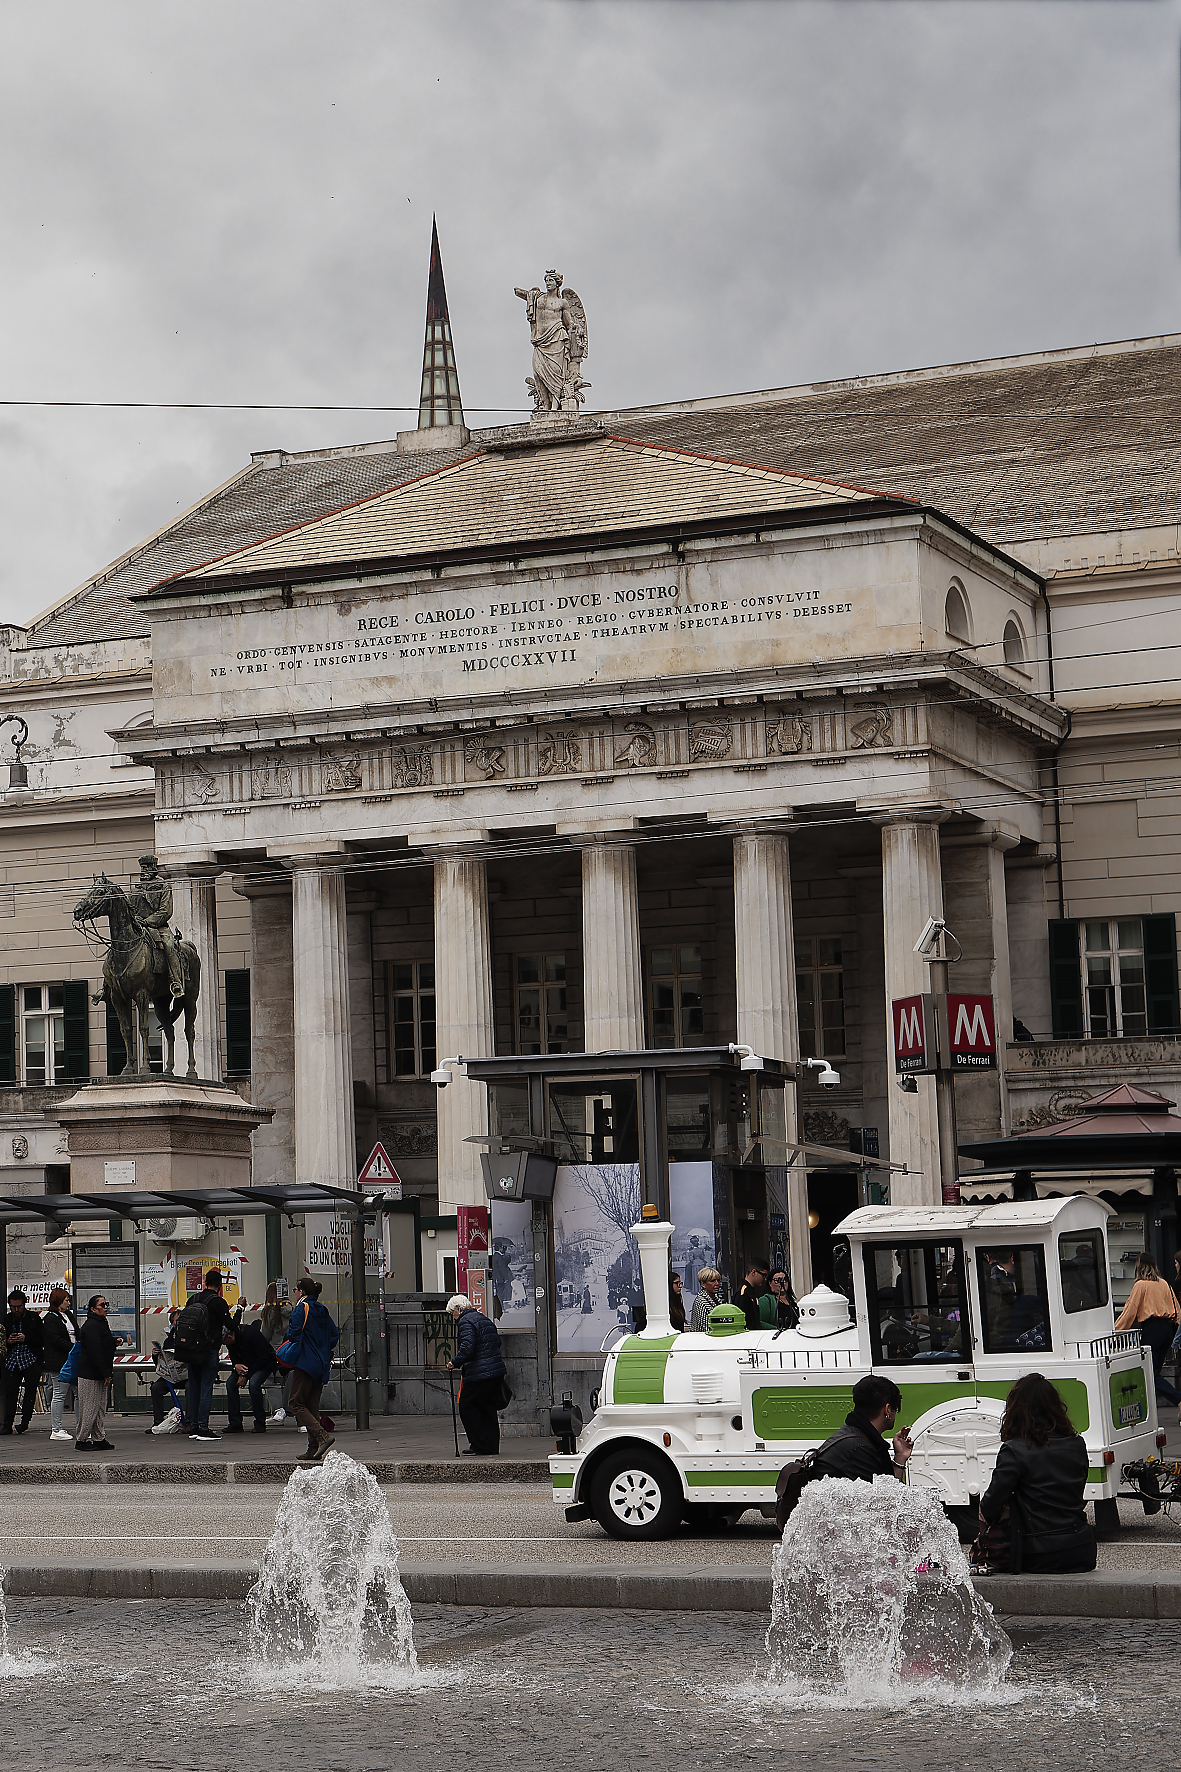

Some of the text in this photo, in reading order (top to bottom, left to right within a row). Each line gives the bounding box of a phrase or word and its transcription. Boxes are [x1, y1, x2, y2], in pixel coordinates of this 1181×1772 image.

[236, 649, 267, 660] ORDO
[274, 641, 344, 657] GENVENSIS
[354, 632, 427, 649] SATAGENTE
[439, 625, 498, 640] HECTORE
[577, 613, 617, 625] REGIO
[628, 601, 729, 620] GVBERNATORE
[741, 590, 821, 608] CONSVLVIT
[357, 585, 679, 631] REGE CAROLO FELICI DVCE NOSTRO
[210, 603, 853, 677] NE VRBI TOT INSIGNIBVS MONVMENTIS INSTRVCTAE THEATRVM SPECTABILIVS DEESSET
[462, 649, 577, 672] MDCCCXXVII
[899, 1006, 923, 1050] M
[954, 1003, 991, 1046] M
[957, 1054, 991, 1065] De Ferrari
[331, 1252, 353, 1266] CREDIT
